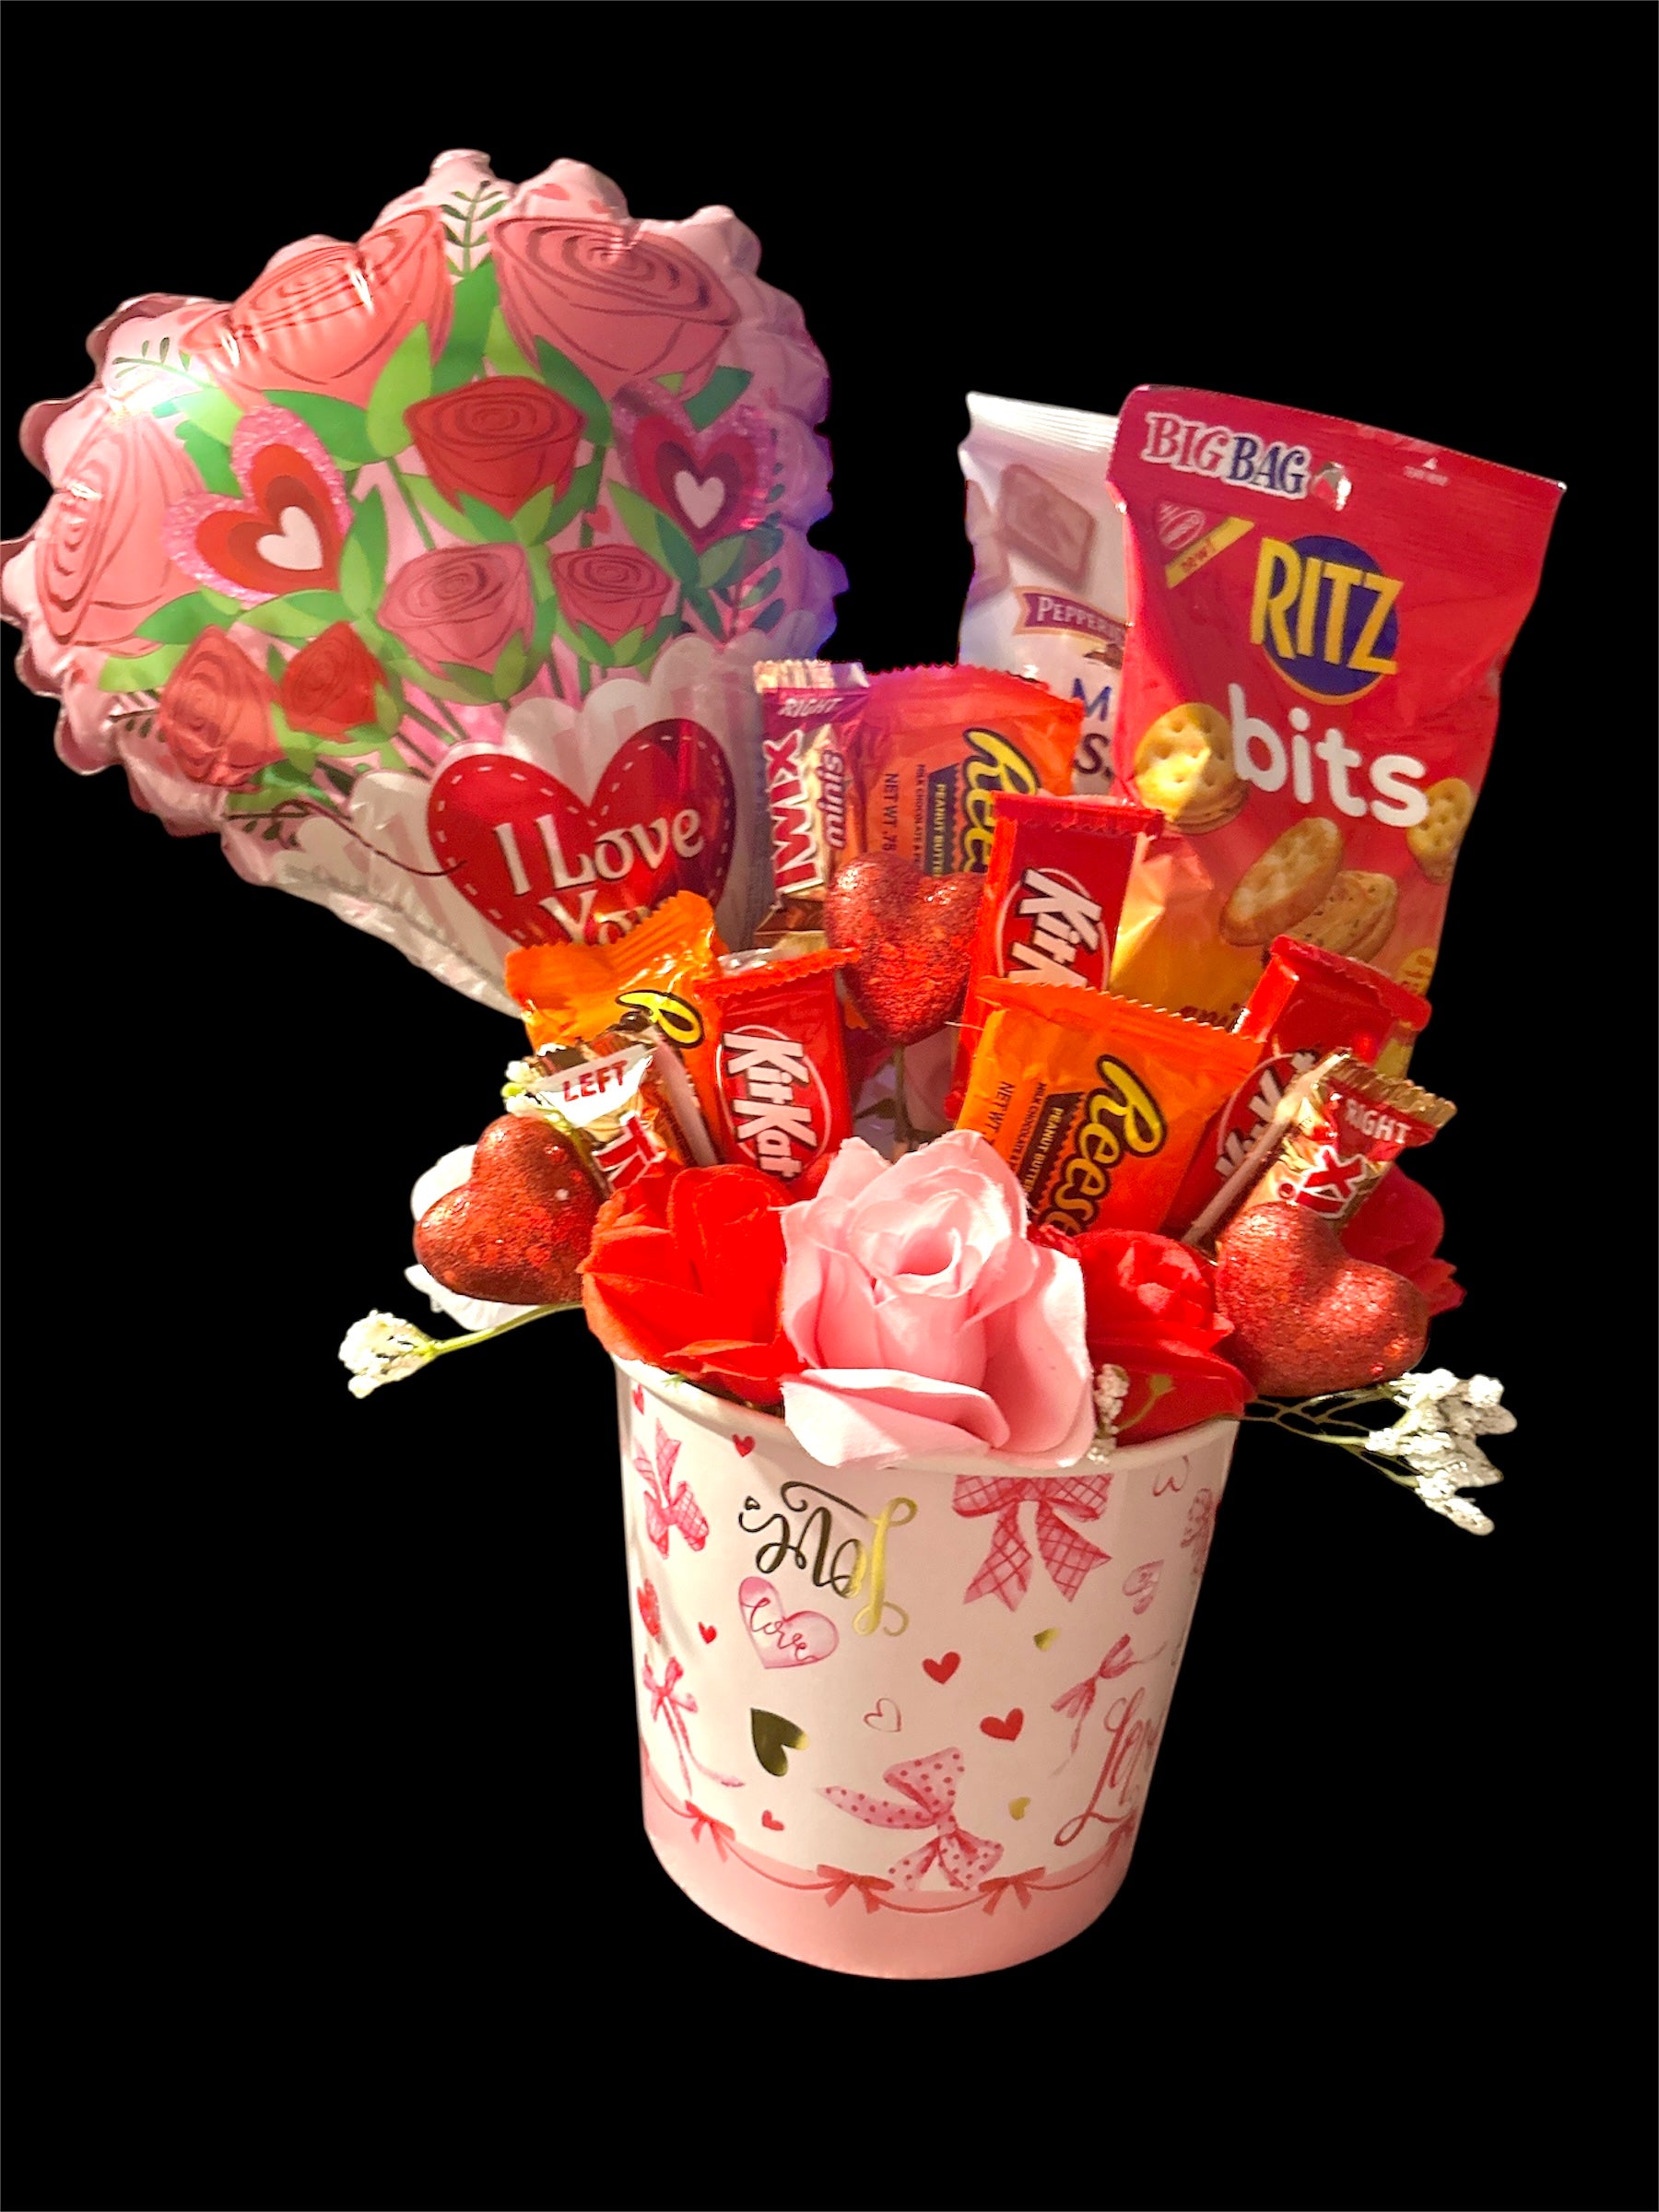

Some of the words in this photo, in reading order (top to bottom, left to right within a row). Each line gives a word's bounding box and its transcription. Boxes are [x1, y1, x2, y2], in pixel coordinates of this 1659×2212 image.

[1251, 536, 1405, 675] RITZ
[778, 697, 844, 717] RIGHT
[1229, 683, 1429, 828] bits
[762, 728, 825, 898] TWIX
[815, 749, 846, 850] minis
[884, 772, 900, 803] NET
[494, 821, 531, 896] I
[535, 806, 706, 891] Love
[1008, 868, 1102, 990] KitK
[562, 1060, 629, 1101] LEFT
[722, 1030, 819, 1182] KitKat
[996, 1081, 1016, 1108] NET
[1345, 1098, 1412, 1144] RIGHT
[1037, 1106, 1065, 1159] PEANUT
[1038, 1054, 1167, 1235] Reese
[738, 1480, 918, 1637] Love
